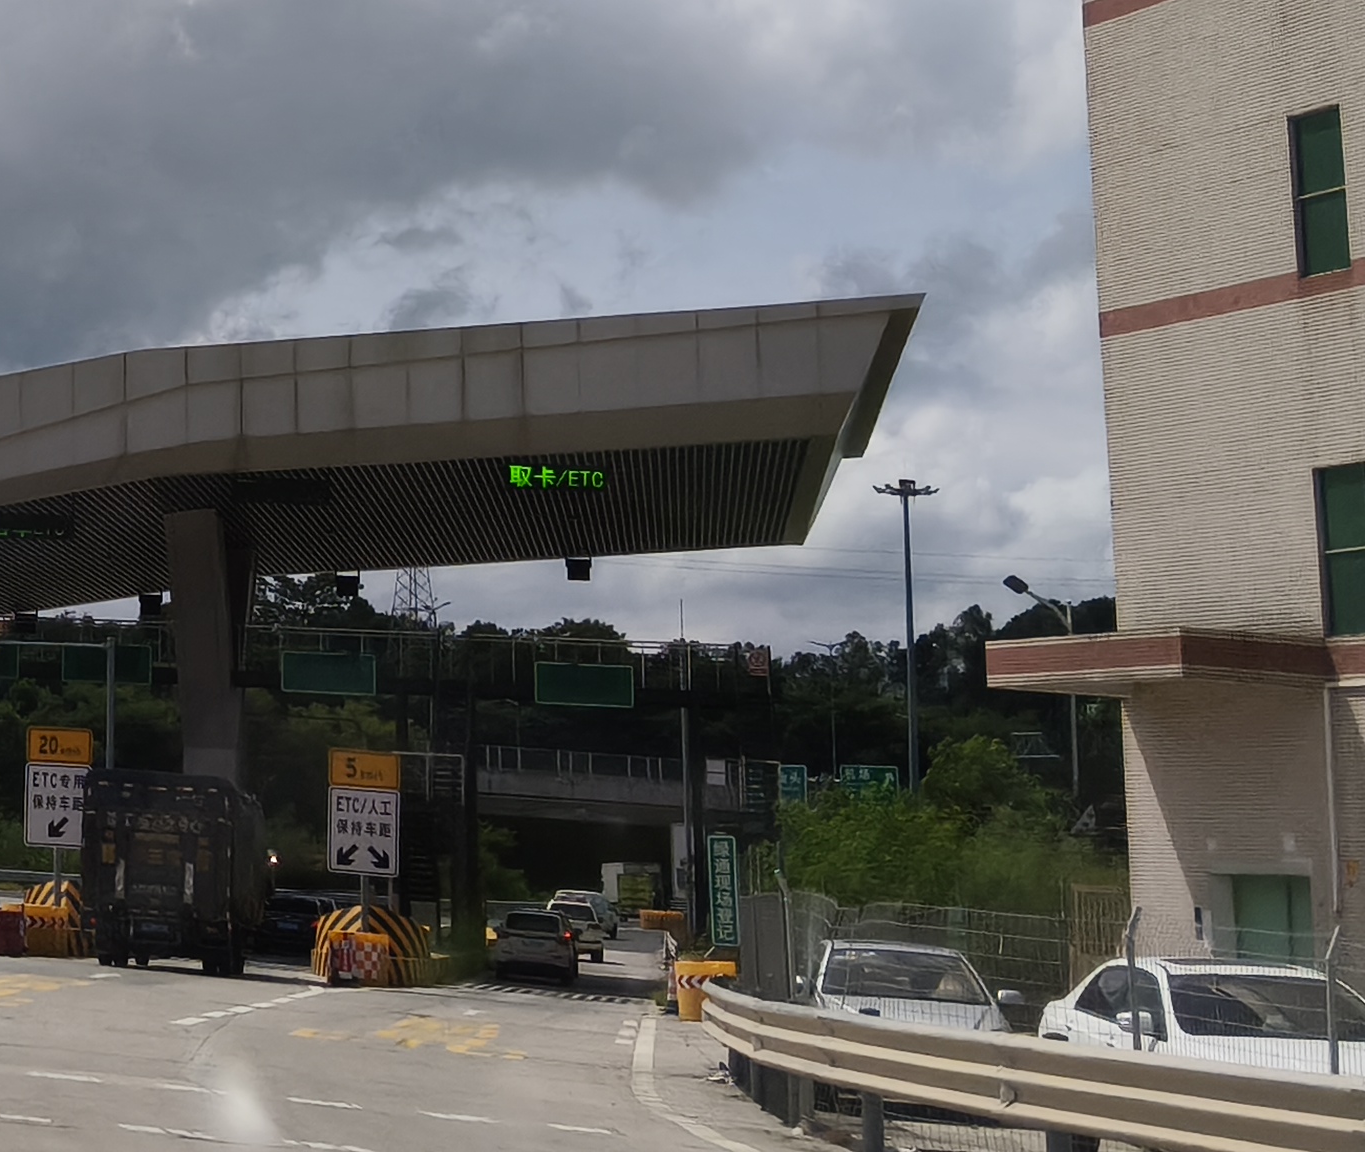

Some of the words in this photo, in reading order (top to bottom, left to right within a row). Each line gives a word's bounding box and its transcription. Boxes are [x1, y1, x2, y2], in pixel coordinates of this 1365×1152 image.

[509, 465, 604, 488] 取卡/ETC
[39, 735, 58, 755] 20
[346, 757, 357, 779] 5
[32, 772, 86, 789] ETC专用
[32, 794, 84, 812] 保持车距
[336, 796, 392, 816] ETC/人工
[336, 818, 392, 838] 保持车距
